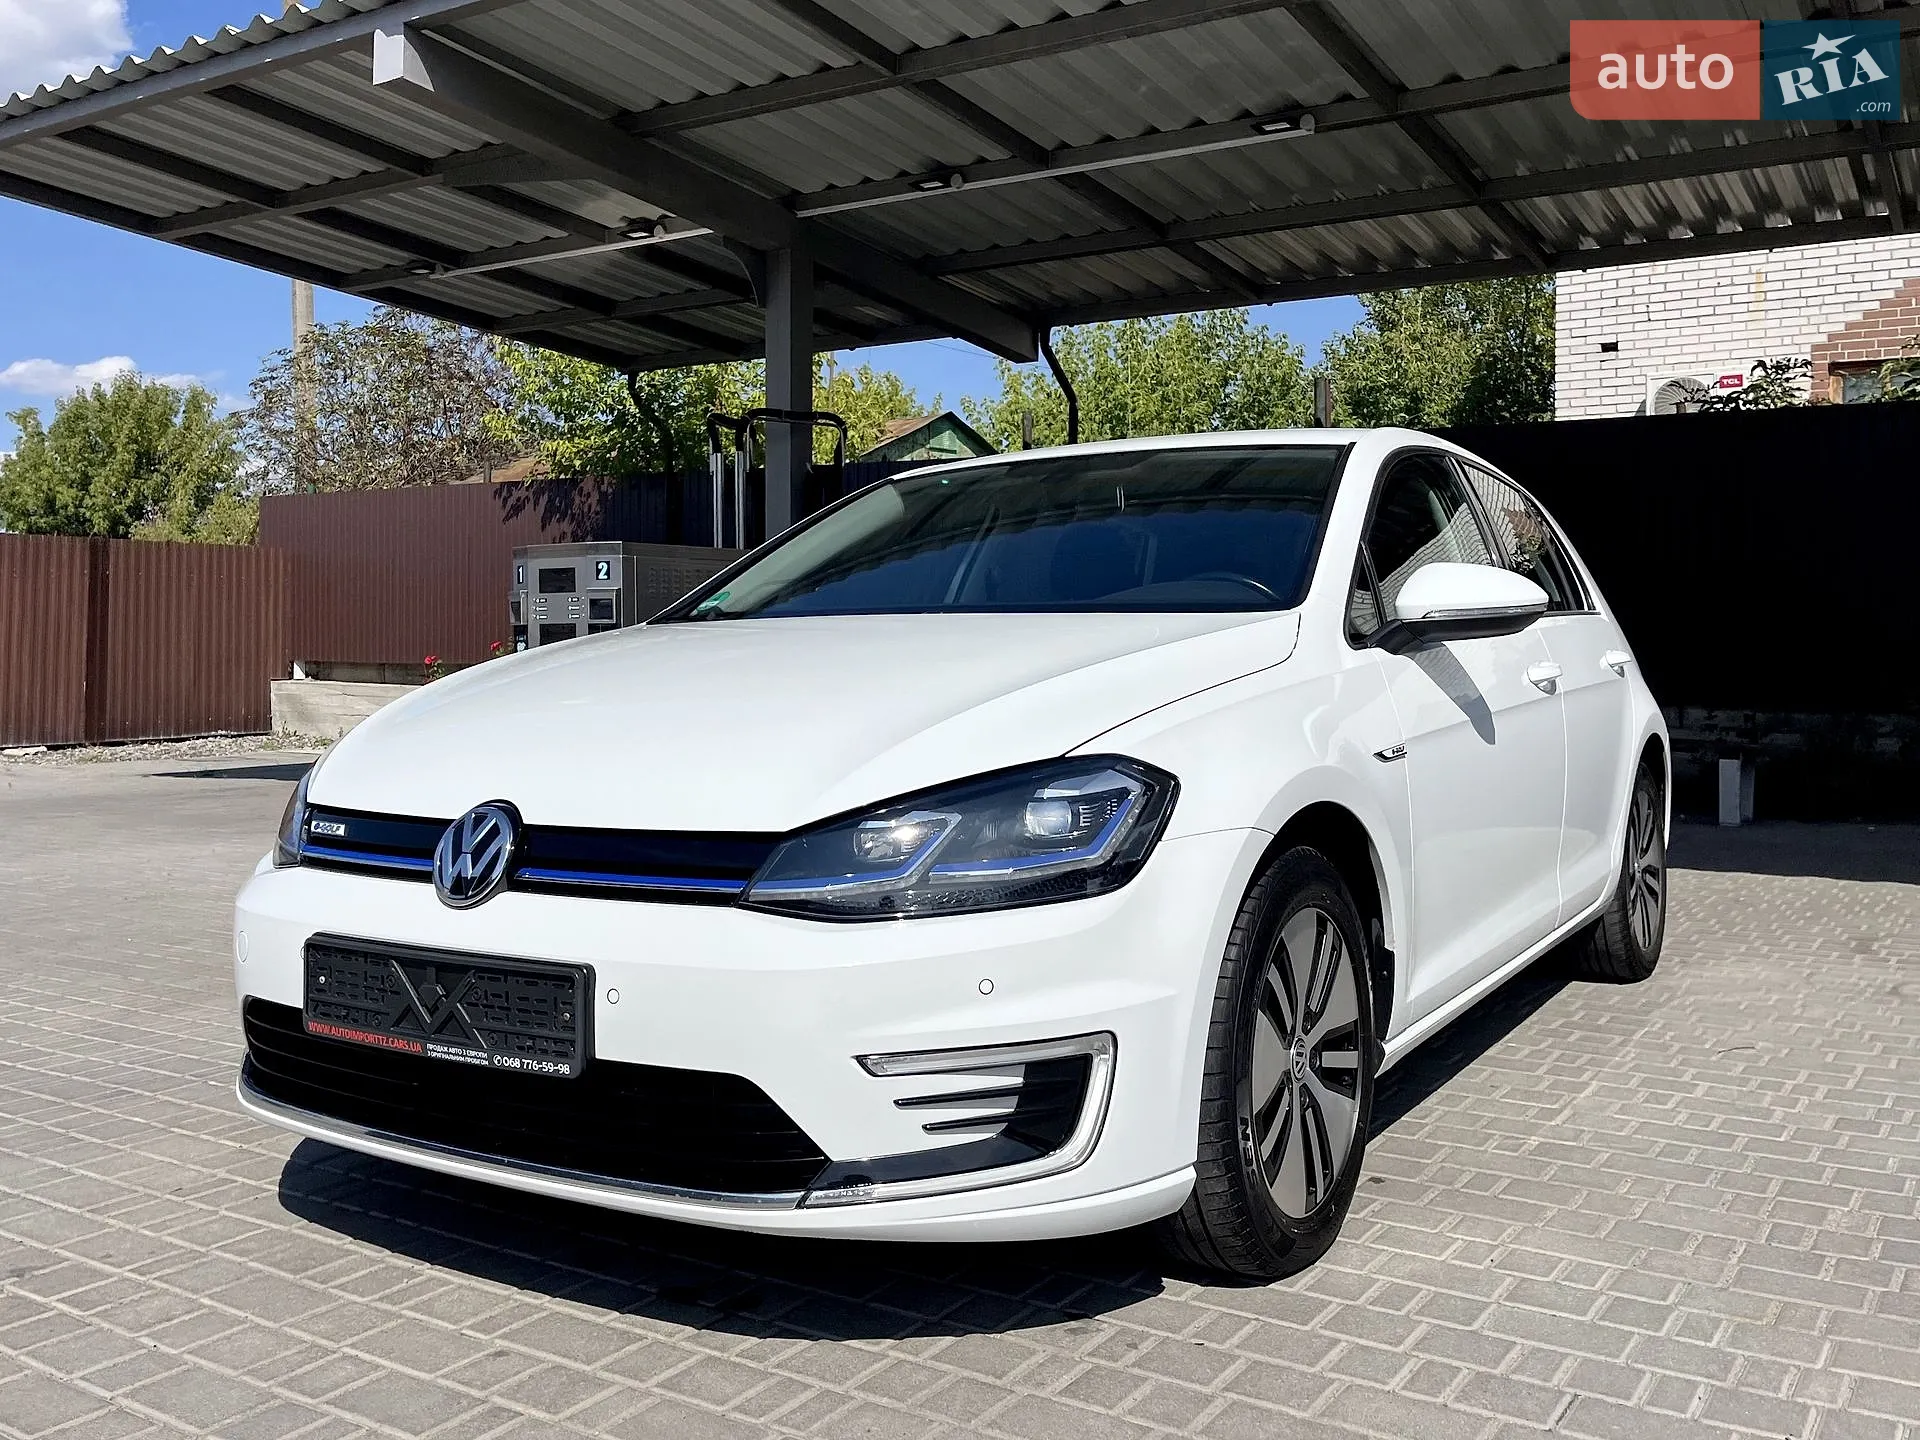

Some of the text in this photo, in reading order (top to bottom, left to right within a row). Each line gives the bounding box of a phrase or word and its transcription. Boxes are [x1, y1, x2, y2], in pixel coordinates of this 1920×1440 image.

[518, 566, 524, 583] 1
[597, 562, 609, 580] 2
[502, 1056, 571, 1075] 068 776-59-98
